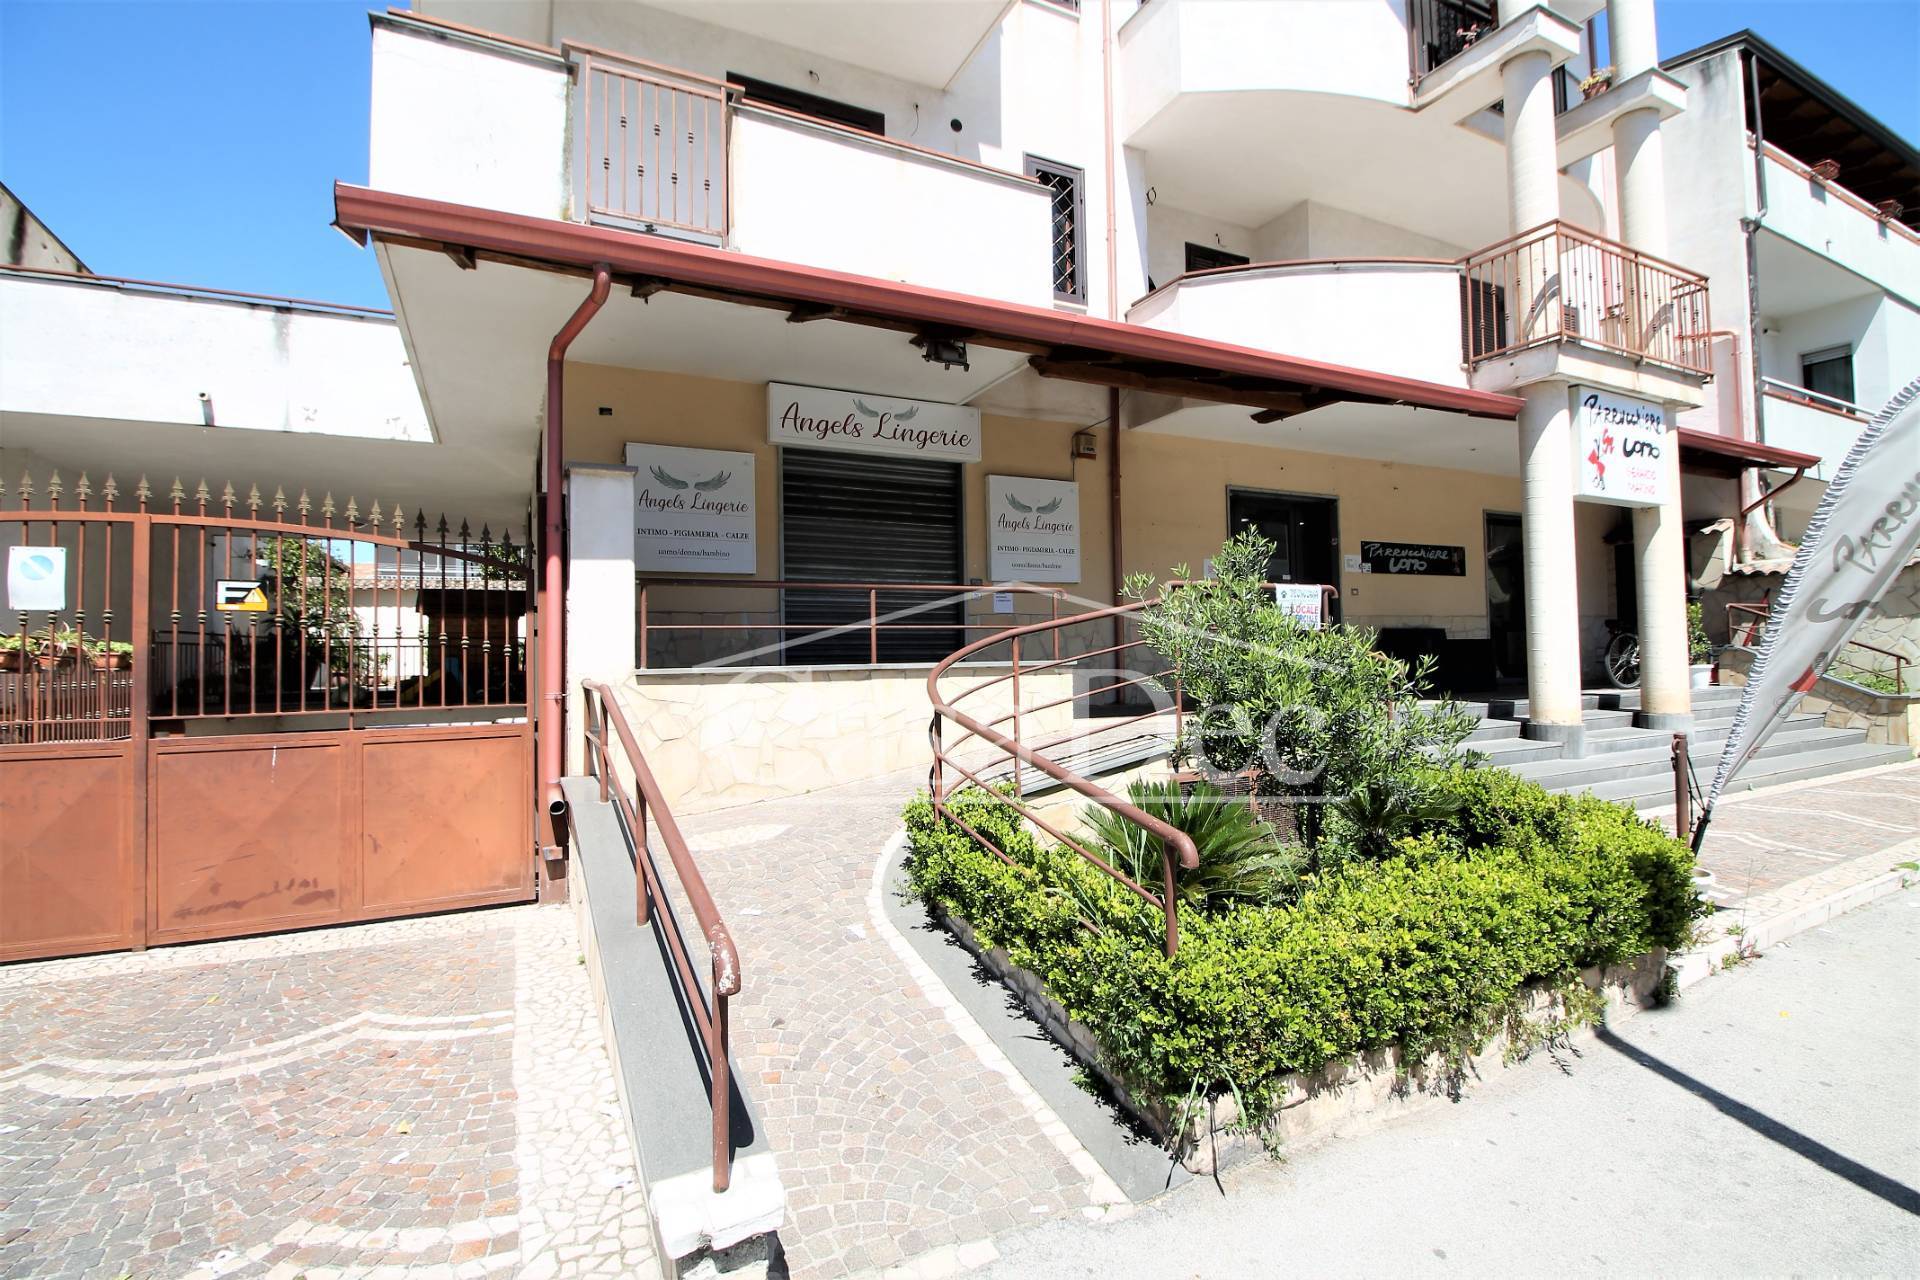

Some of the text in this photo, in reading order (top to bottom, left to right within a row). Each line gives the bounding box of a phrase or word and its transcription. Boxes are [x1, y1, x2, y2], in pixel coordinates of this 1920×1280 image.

[779, 401, 972, 450] Angels Lingerie
[638, 488, 749, 515] Angels Lingerie
[637, 527, 668, 536] INTIMO
[673, 529, 719, 538] PIGIAMERIA
[725, 532, 750, 540] CALZE
[998, 512, 1073, 534] Angels Lingerie
[1058, 547, 1075, 555] CALZE
